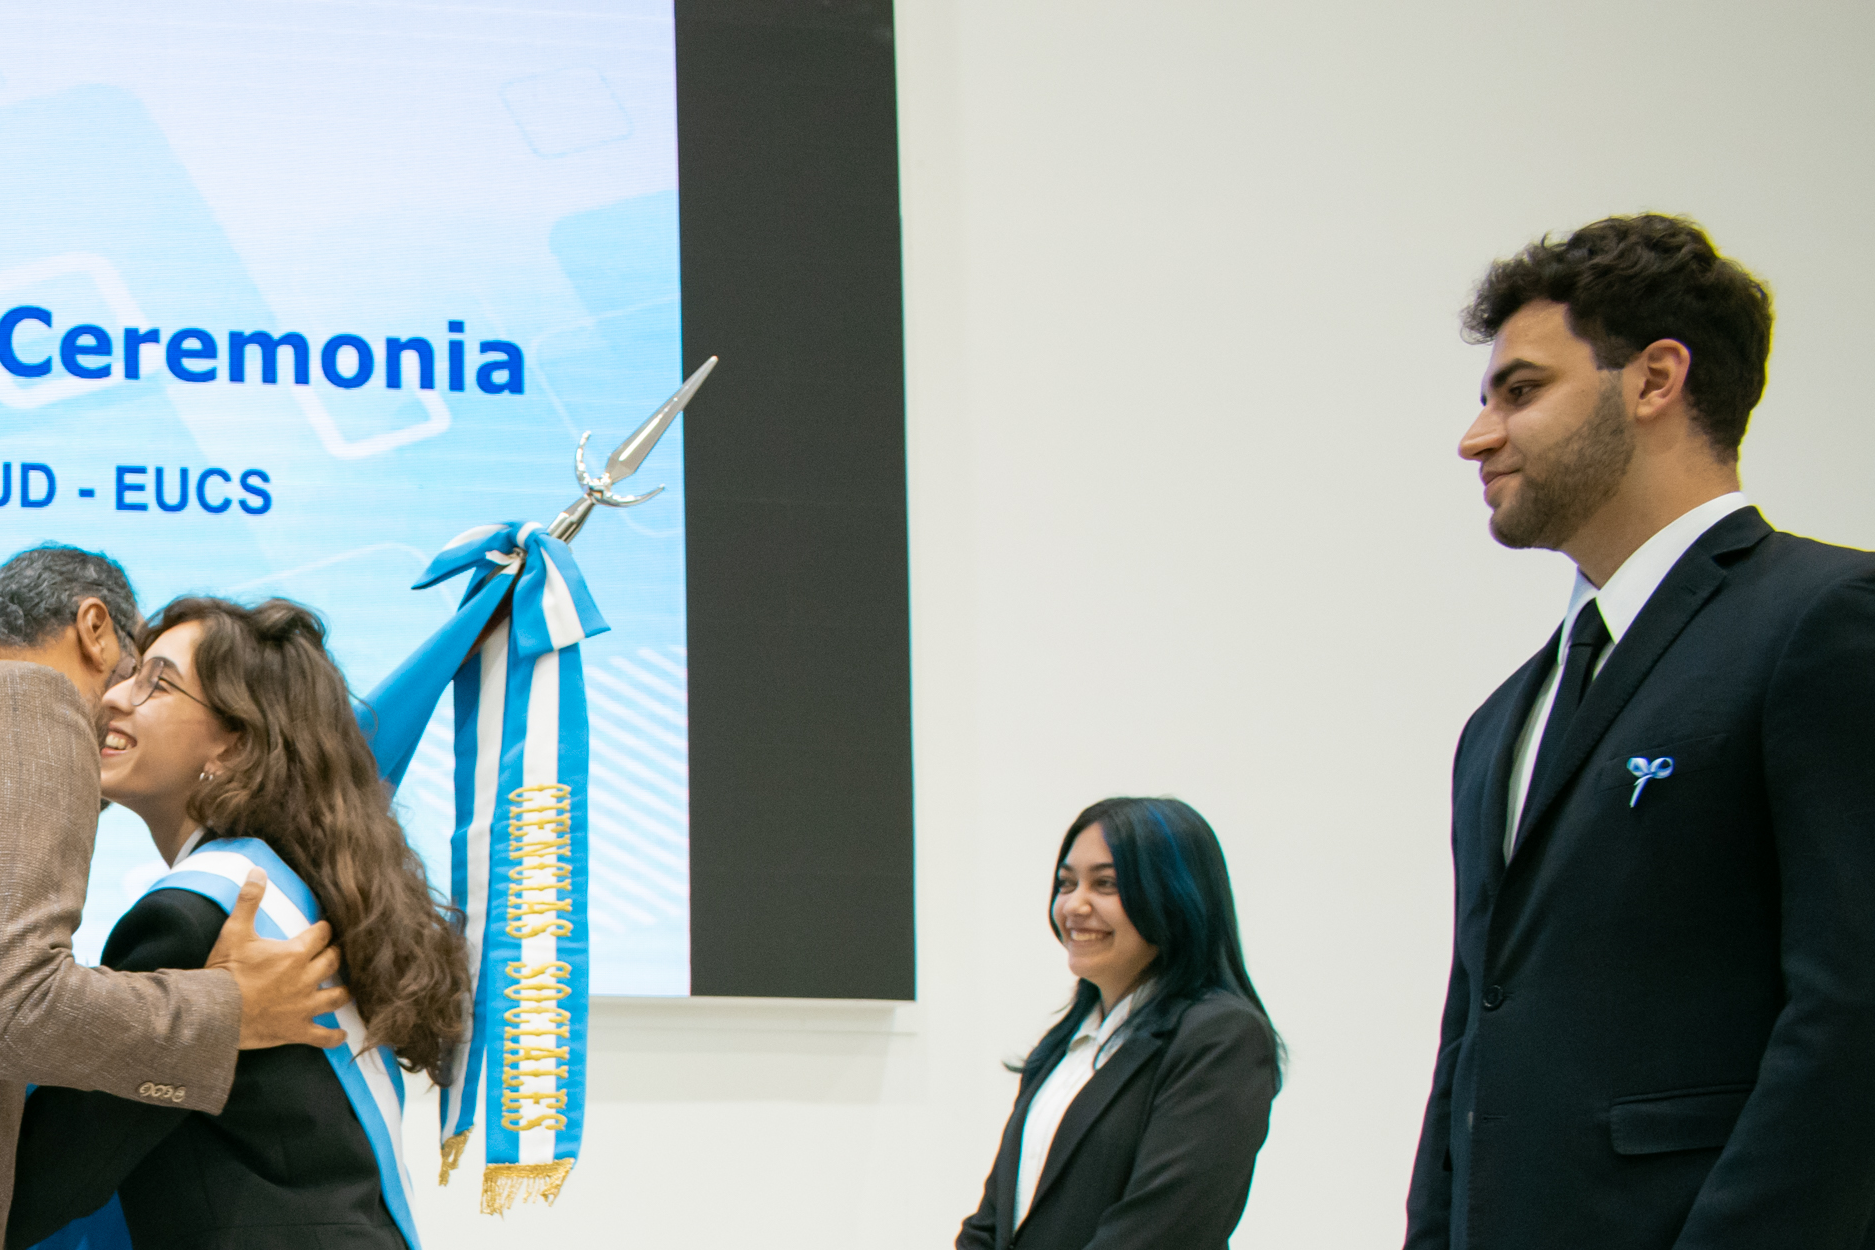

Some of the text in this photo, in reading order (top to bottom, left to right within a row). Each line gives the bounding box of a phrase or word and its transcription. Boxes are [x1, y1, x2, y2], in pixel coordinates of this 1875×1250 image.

[115, 465, 272, 516] EUCS
[502, 783, 574, 1132] CIENCIAS SOCIALES
